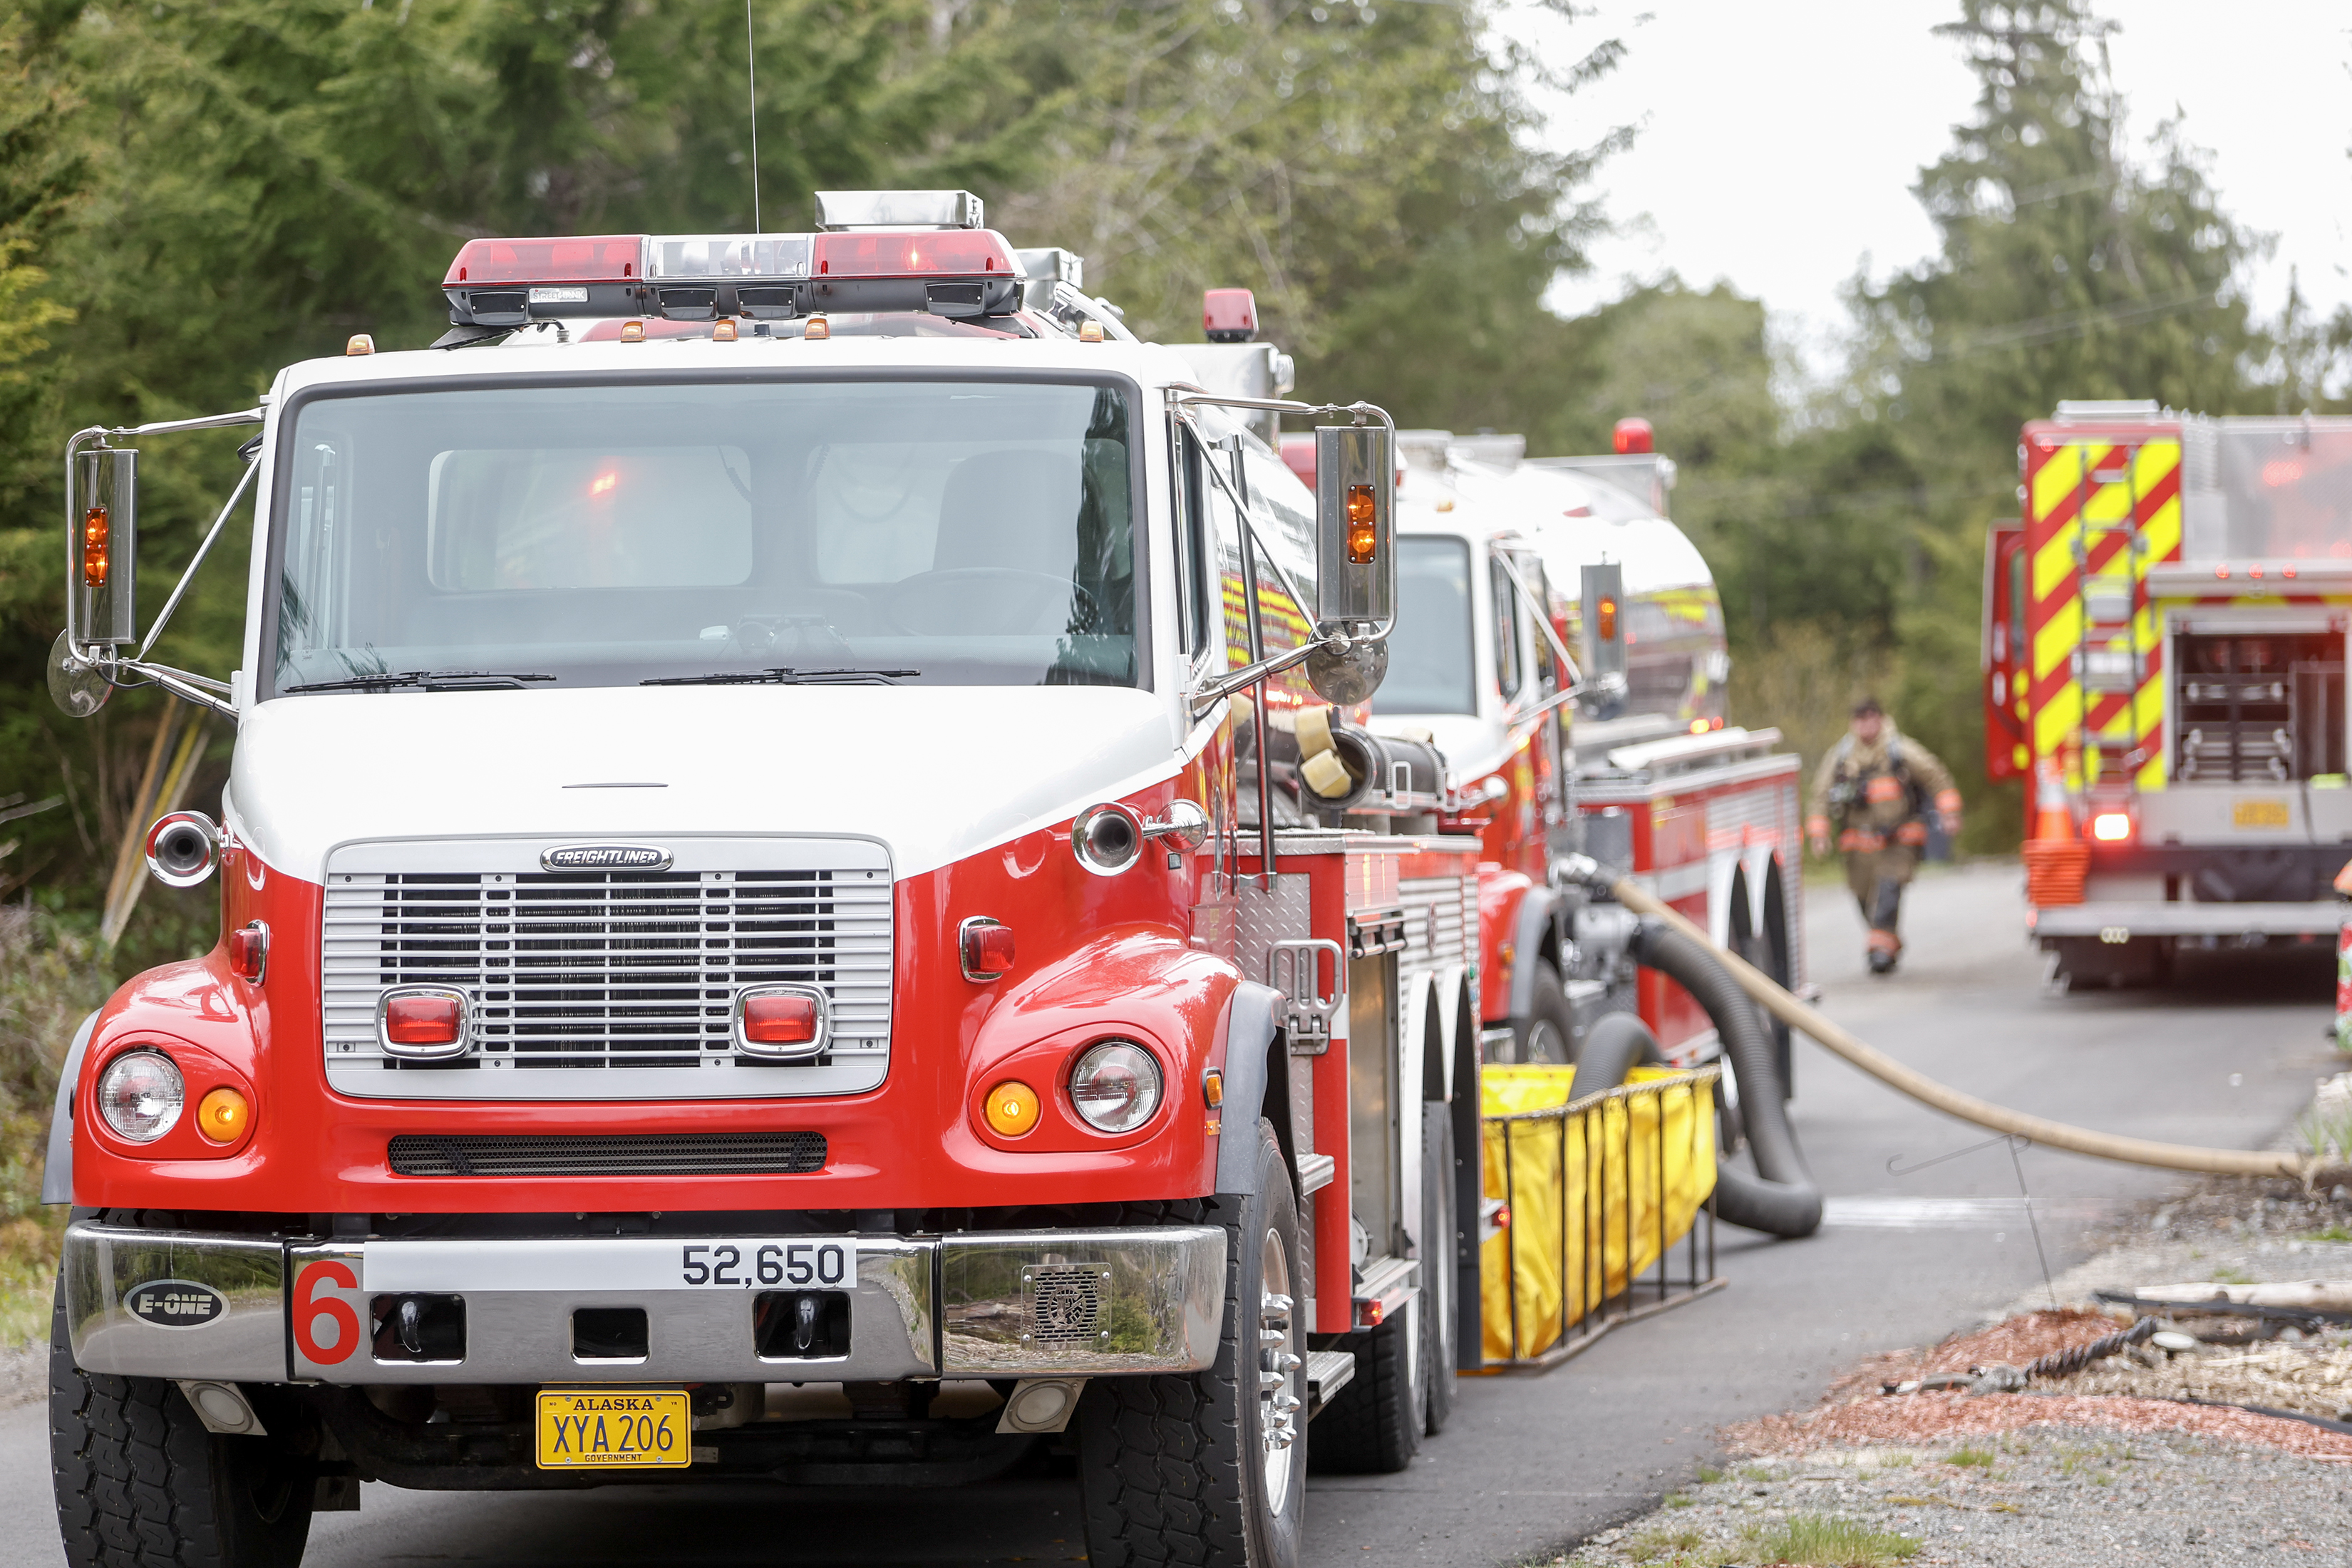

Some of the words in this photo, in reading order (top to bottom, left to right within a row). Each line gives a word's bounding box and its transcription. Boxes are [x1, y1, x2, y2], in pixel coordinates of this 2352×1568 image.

[555, 850, 658, 864] FREIGHTLINER
[684, 1245, 844, 1289] 52,650
[138, 1293, 212, 1314] E-ONE
[292, 1260, 360, 1365] 6
[573, 1399, 654, 1410] ALASKA
[552, 1414, 609, 1452] XYA
[618, 1414, 674, 1451] 206
